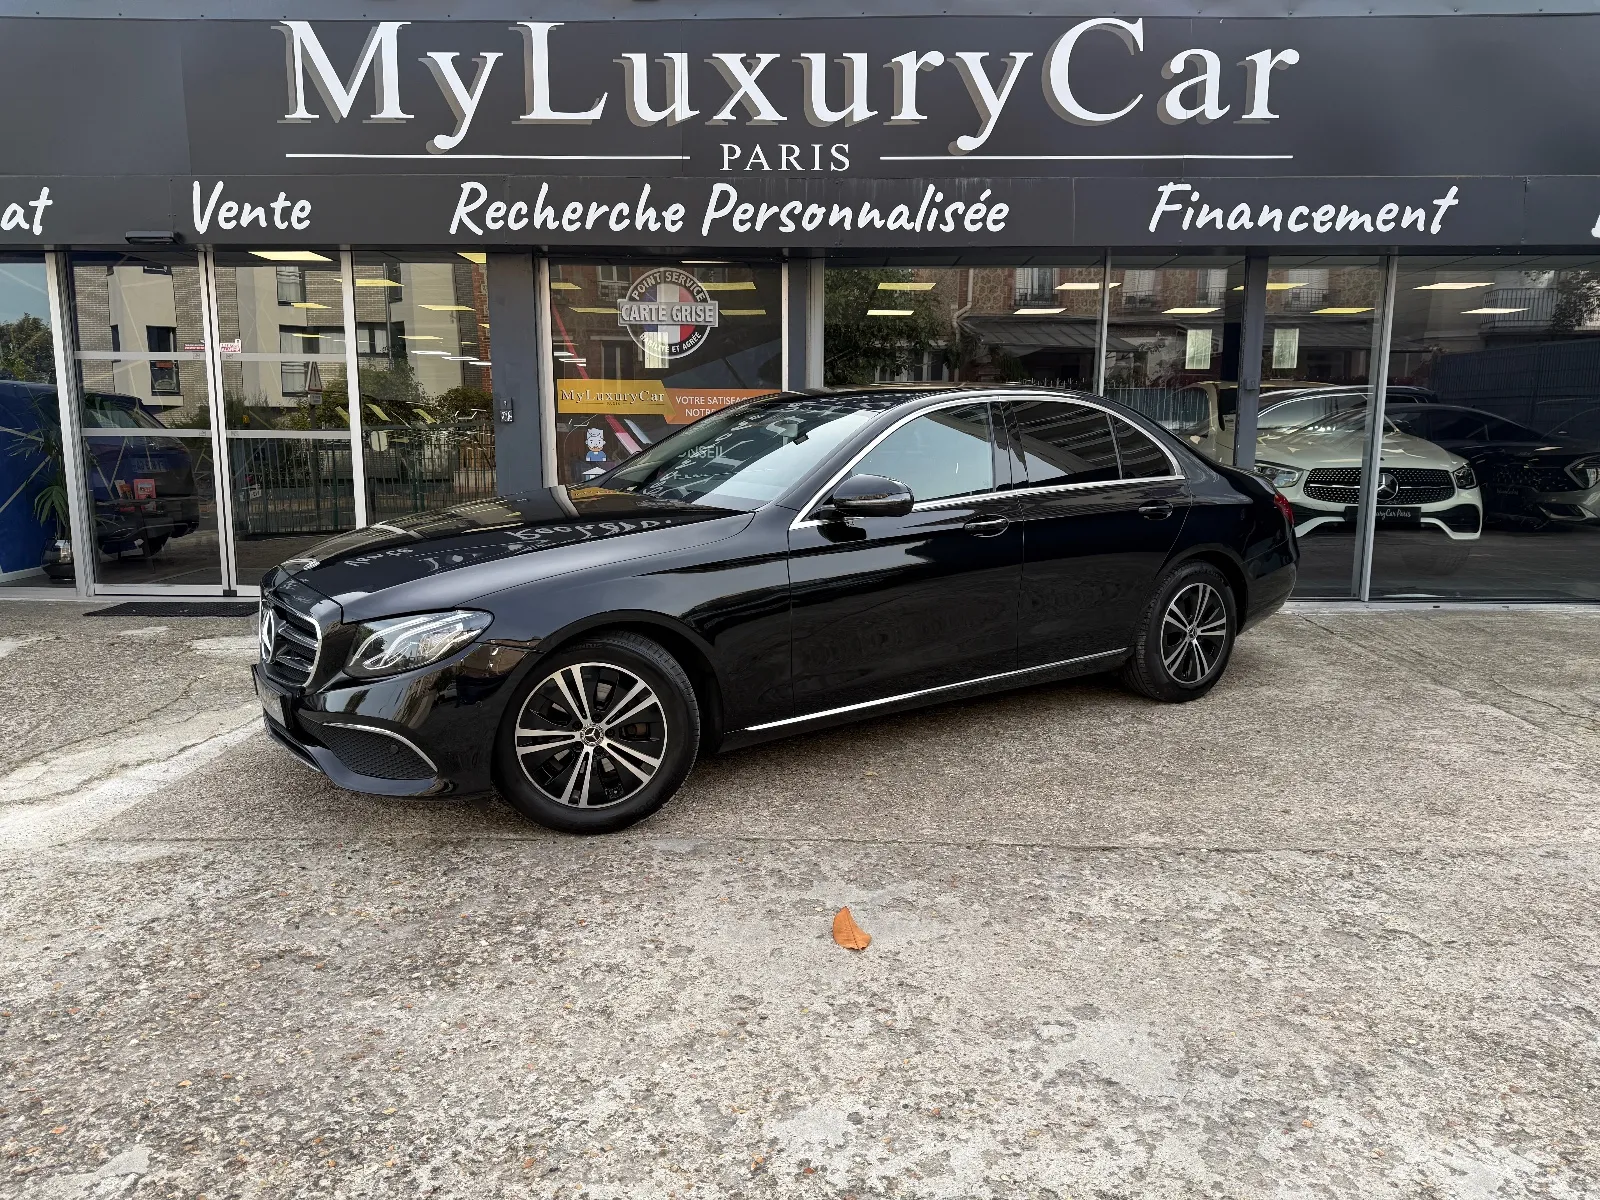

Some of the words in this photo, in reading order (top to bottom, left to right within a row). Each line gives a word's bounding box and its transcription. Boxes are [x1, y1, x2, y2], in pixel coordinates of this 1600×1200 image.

[278, 18, 1300, 153] MyLuxuryCar
[720, 143, 850, 172] PARIS
[192, 181, 312, 235] Vente
[448, 181, 686, 236] Recherche
[702, 183, 1010, 237] Personnalisée
[1149, 181, 1459, 235] Financement
[631, 273, 661, 301] POINT
[665, 271, 706, 302] SERVICE
[621, 304, 668, 322] CARTE
[671, 305, 714, 323] GRISE
[671, 345, 680, 353] ET
[560, 389, 664, 404] MyLuxuryCar
[675, 396, 705, 405] VOTRE
